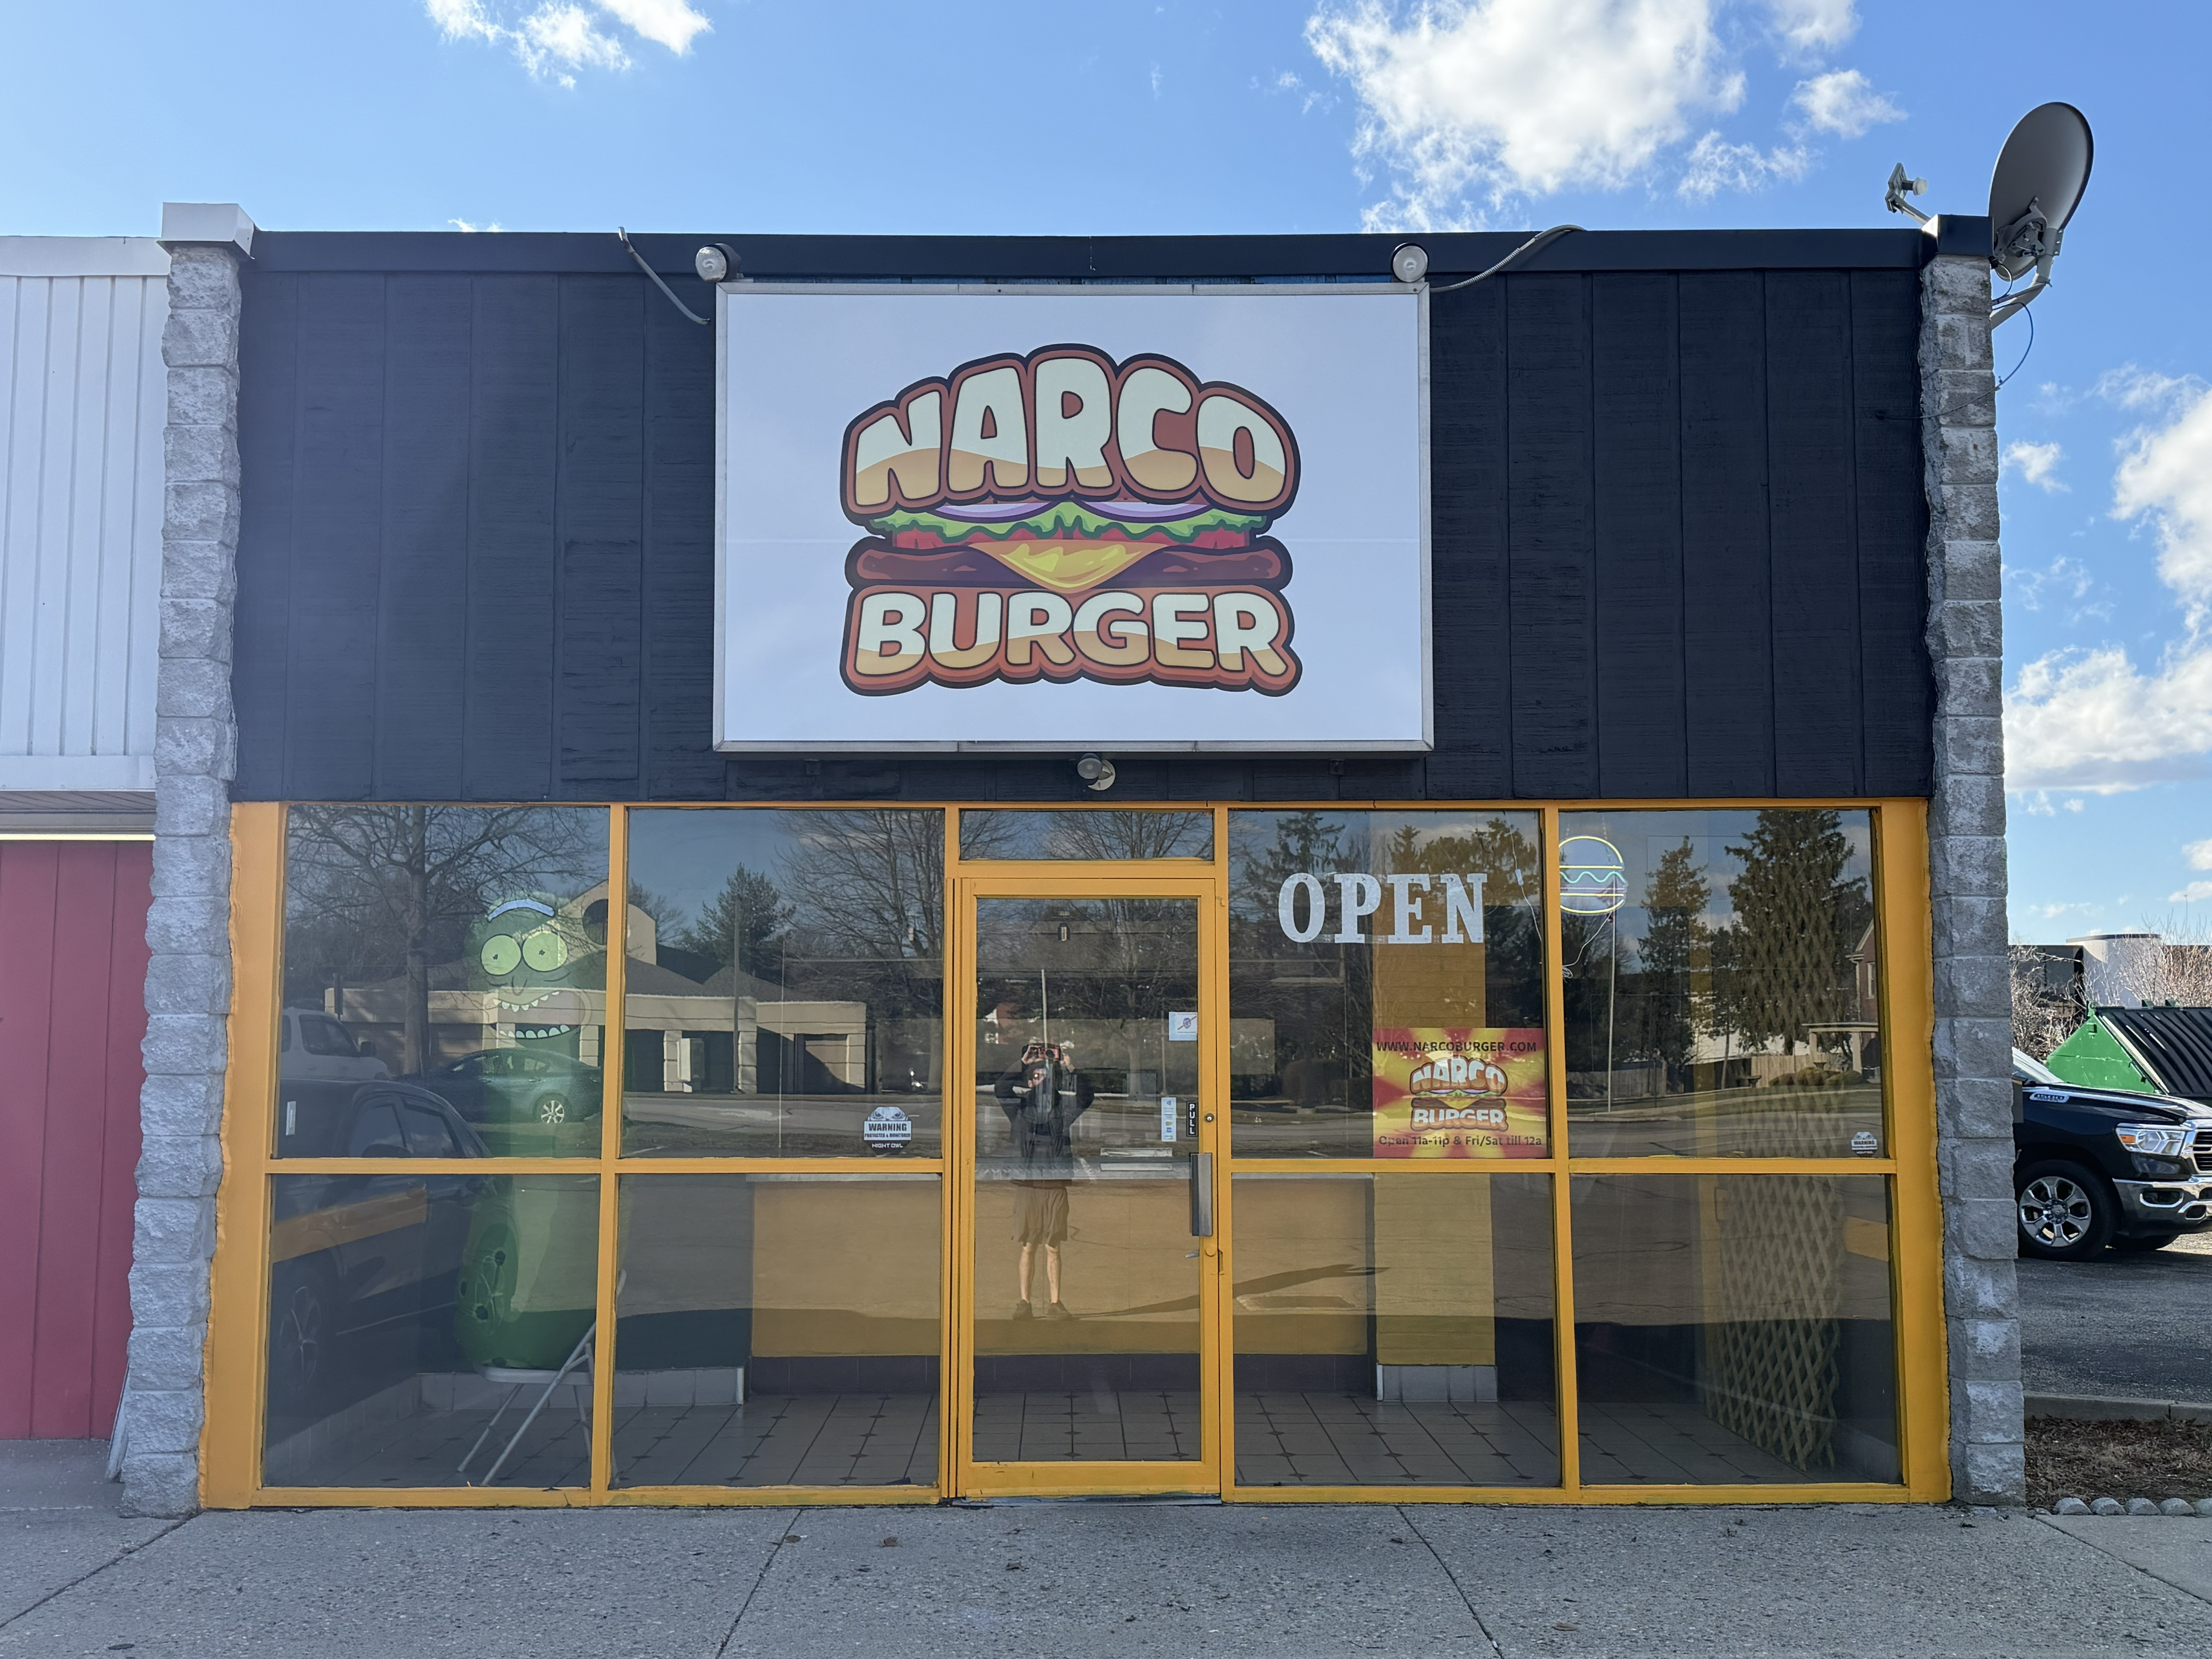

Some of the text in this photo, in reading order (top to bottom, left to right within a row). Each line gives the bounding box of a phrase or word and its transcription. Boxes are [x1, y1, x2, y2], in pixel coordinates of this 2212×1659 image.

[854, 357, 1287, 507] NARCO
[855, 590, 1290, 677] BURGER
[1278, 872, 1488, 944] OPEN
[1376, 1041, 1537, 1052] WWW.NARCOBURGER.COM
[1413, 1058, 1505, 1092] NARCO
[869, 1123, 907, 1131] WARNING
[1413, 1109, 1506, 1128] BURGER
[1379, 1135, 1542, 1147] Open 11a-11p & Fri/Sat till 12a
